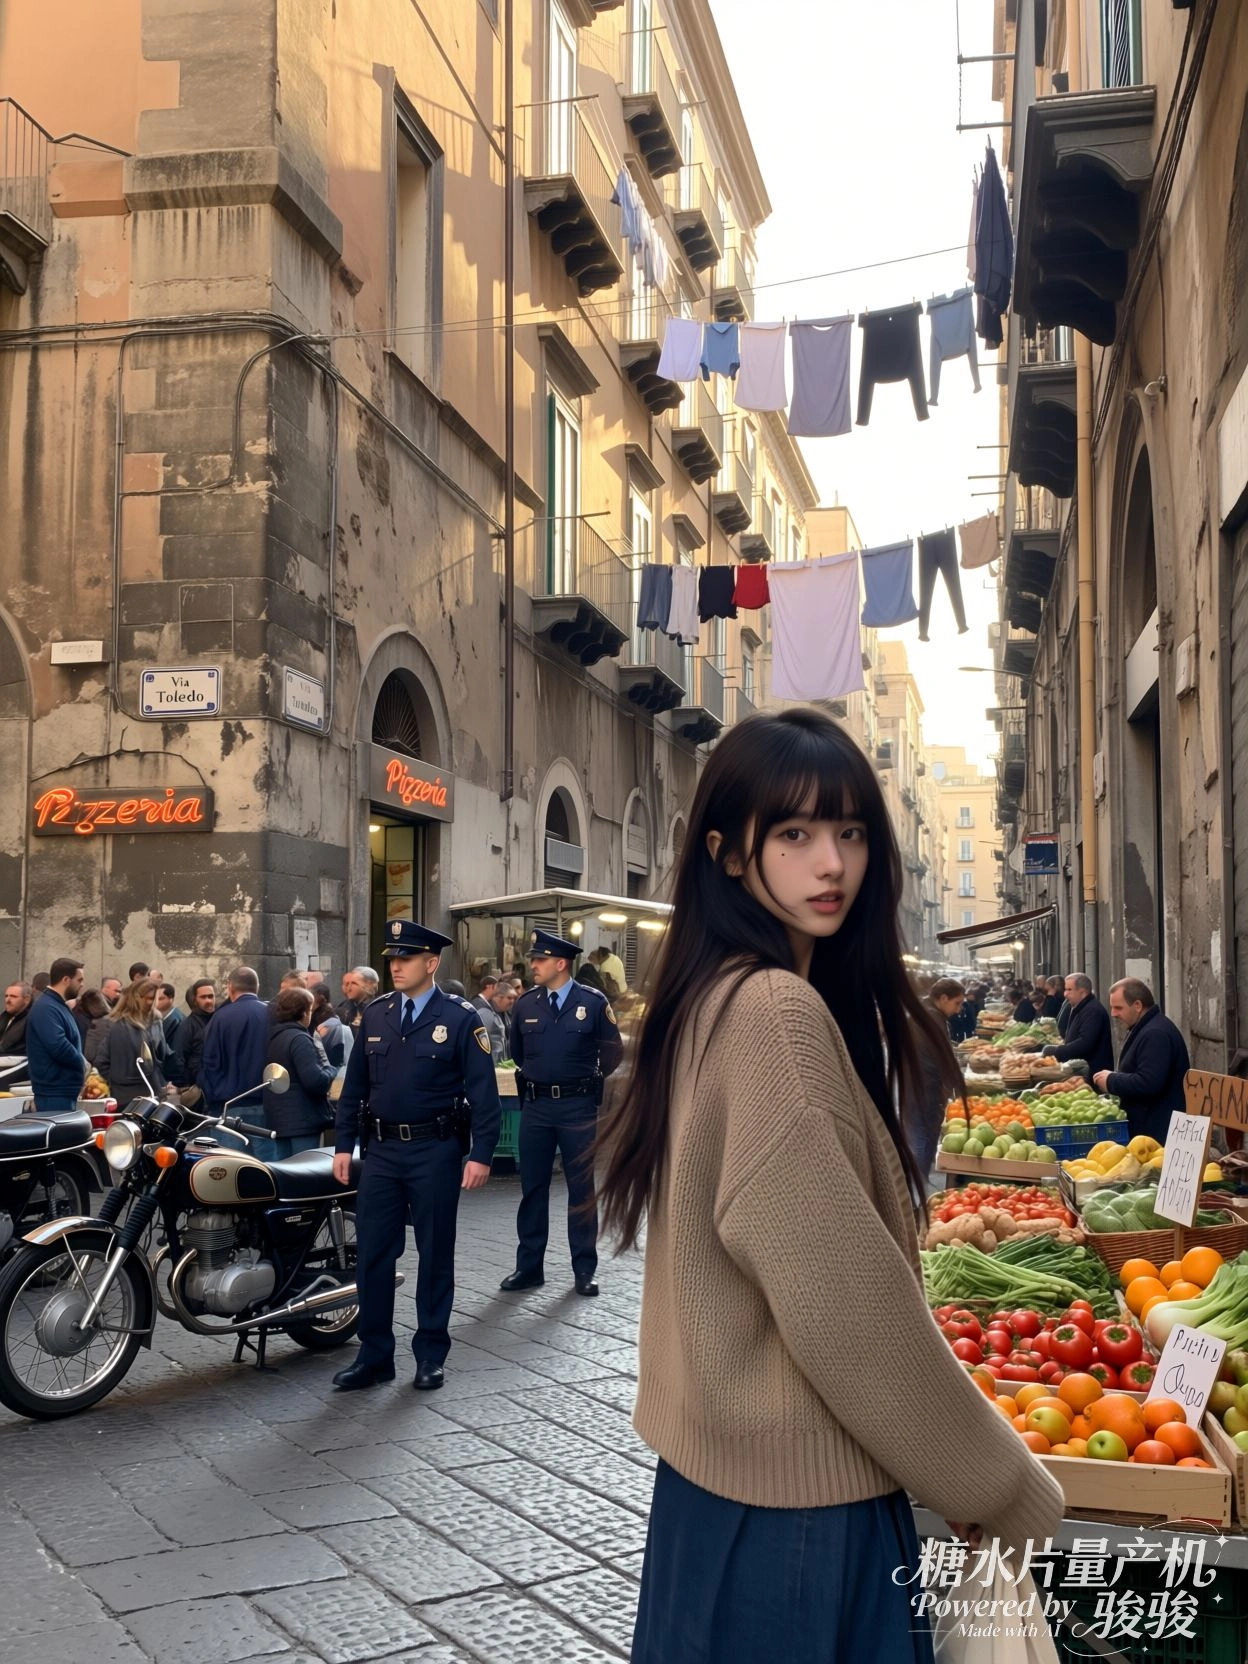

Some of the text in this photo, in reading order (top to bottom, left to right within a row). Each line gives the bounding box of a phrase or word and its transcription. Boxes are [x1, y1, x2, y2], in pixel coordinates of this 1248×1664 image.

[171, 676, 190, 688] Via
[156, 689, 204, 704] Toledo
[386, 758, 448, 808] Pizzeria
